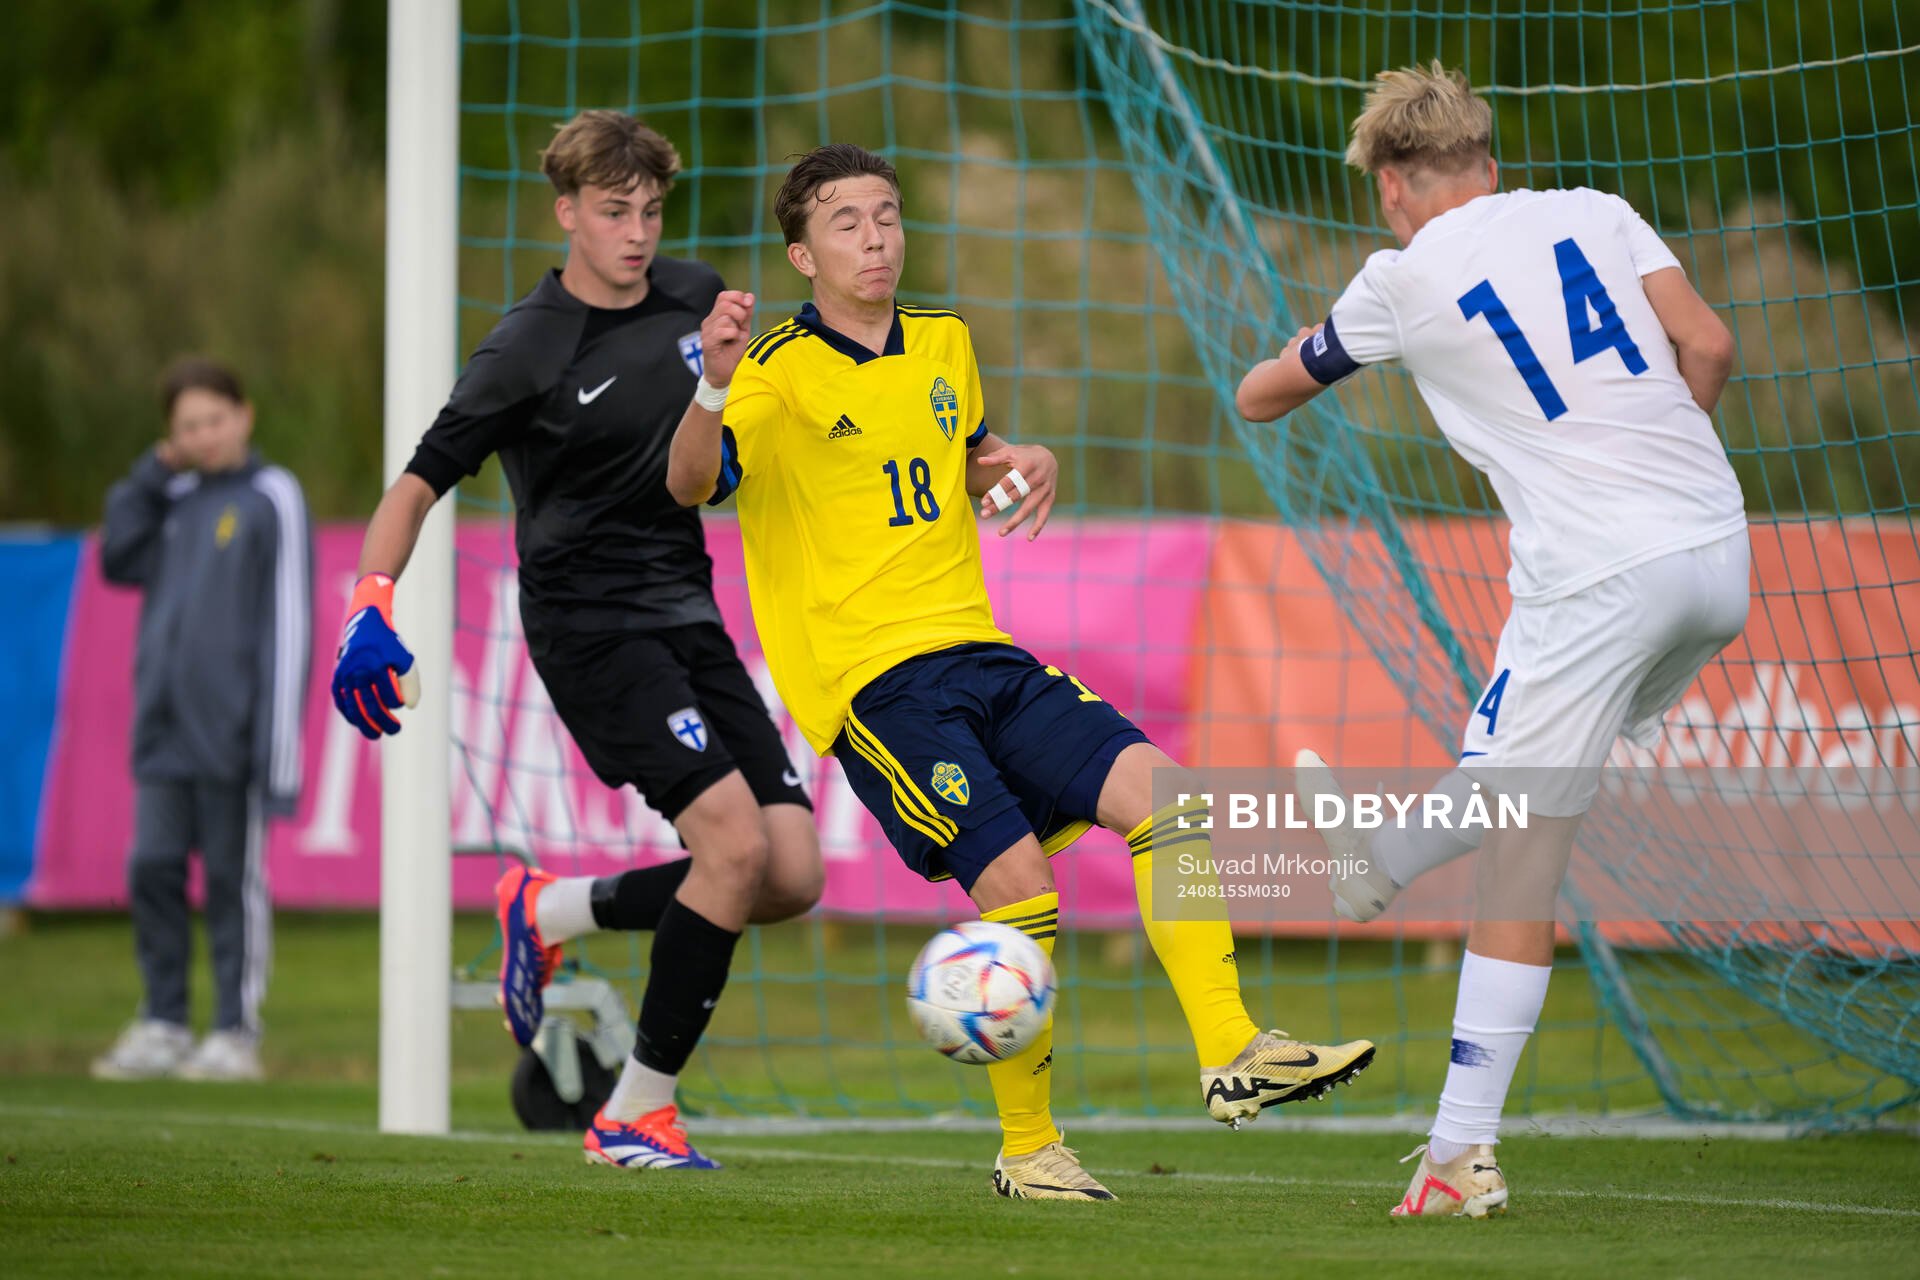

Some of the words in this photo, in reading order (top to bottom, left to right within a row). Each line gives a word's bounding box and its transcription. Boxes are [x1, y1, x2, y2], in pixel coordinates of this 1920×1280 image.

[1457, 237, 1650, 422] 14
[828, 427, 863, 439] adidas
[882, 457, 941, 527] 18
